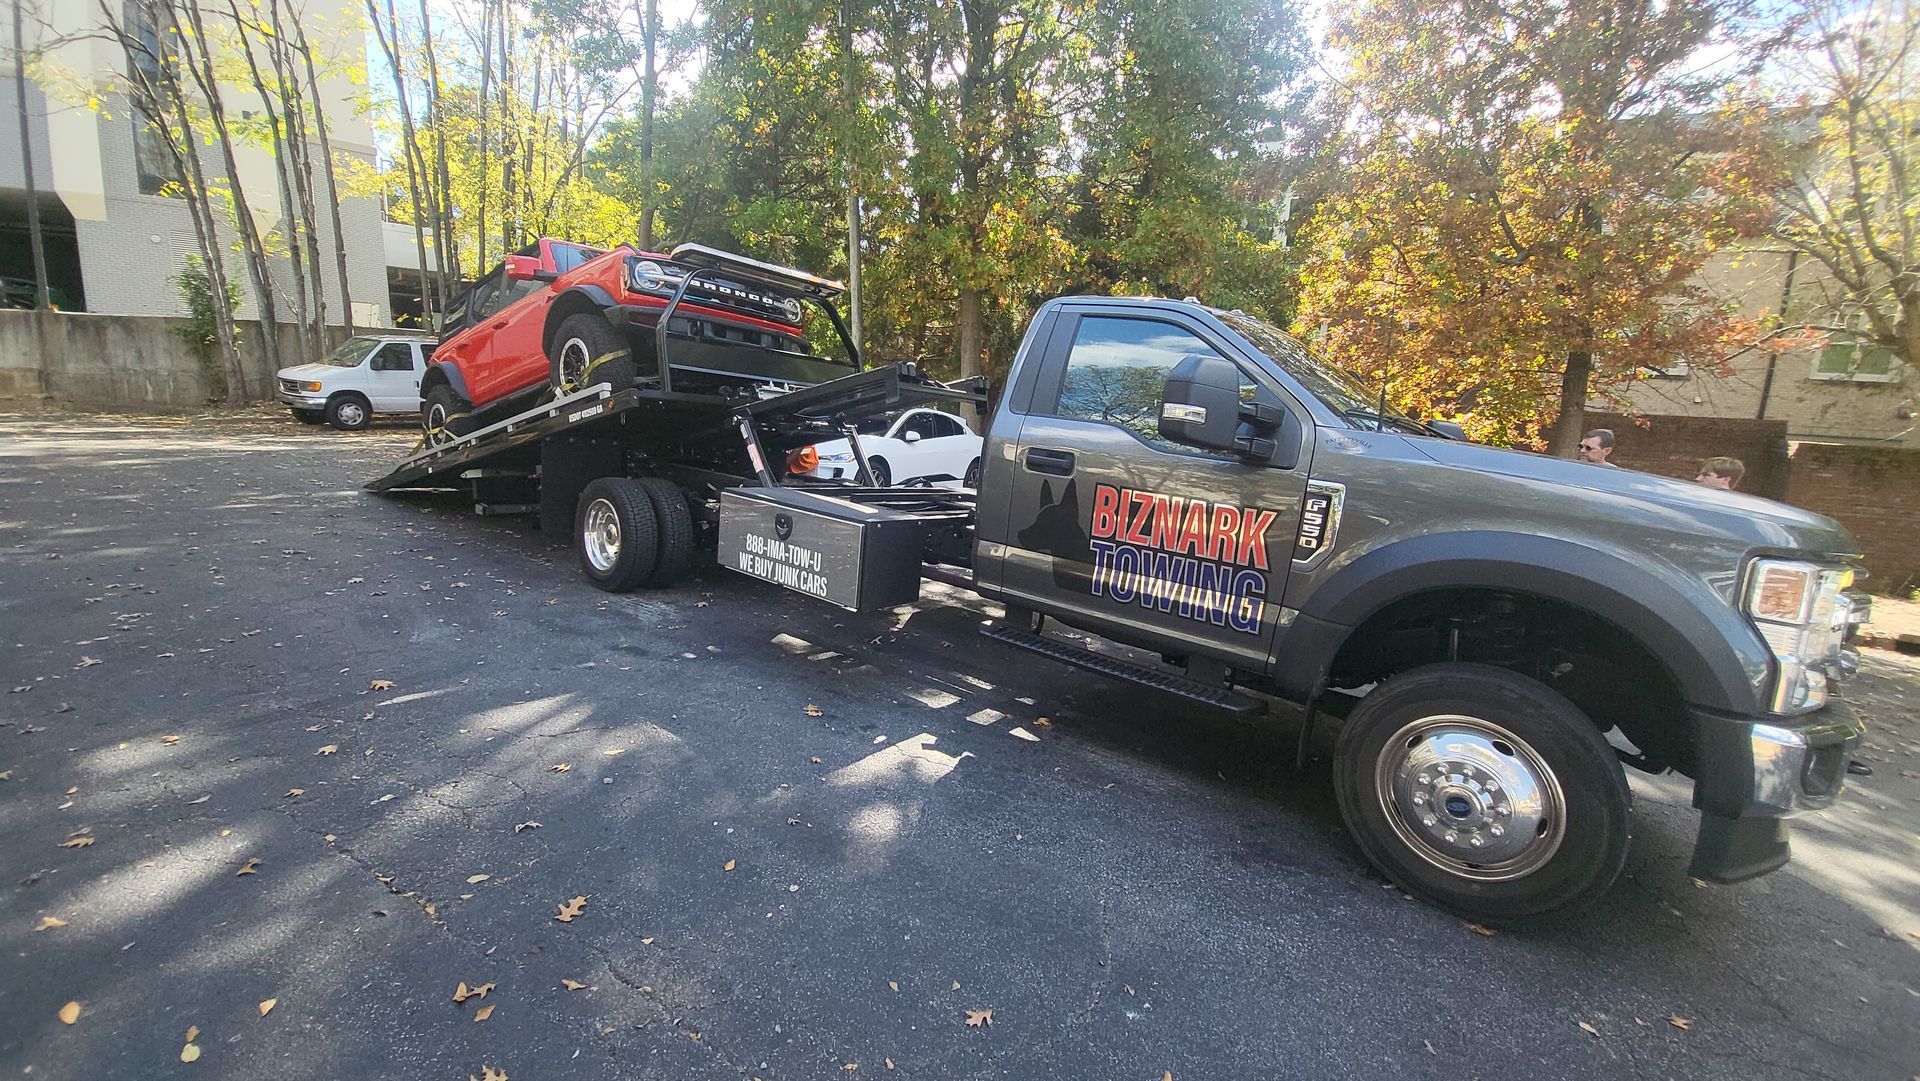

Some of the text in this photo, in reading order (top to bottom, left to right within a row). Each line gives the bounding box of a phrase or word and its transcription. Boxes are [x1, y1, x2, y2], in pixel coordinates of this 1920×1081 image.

[690, 279, 773, 305] BRONCO
[1091, 483, 1277, 571] BIZNARK
[740, 552, 828, 597] WE BUY JUNK CARS
[746, 533, 822, 572] 888-IMA-TOW-U
[1090, 539, 1266, 635] TOWING
